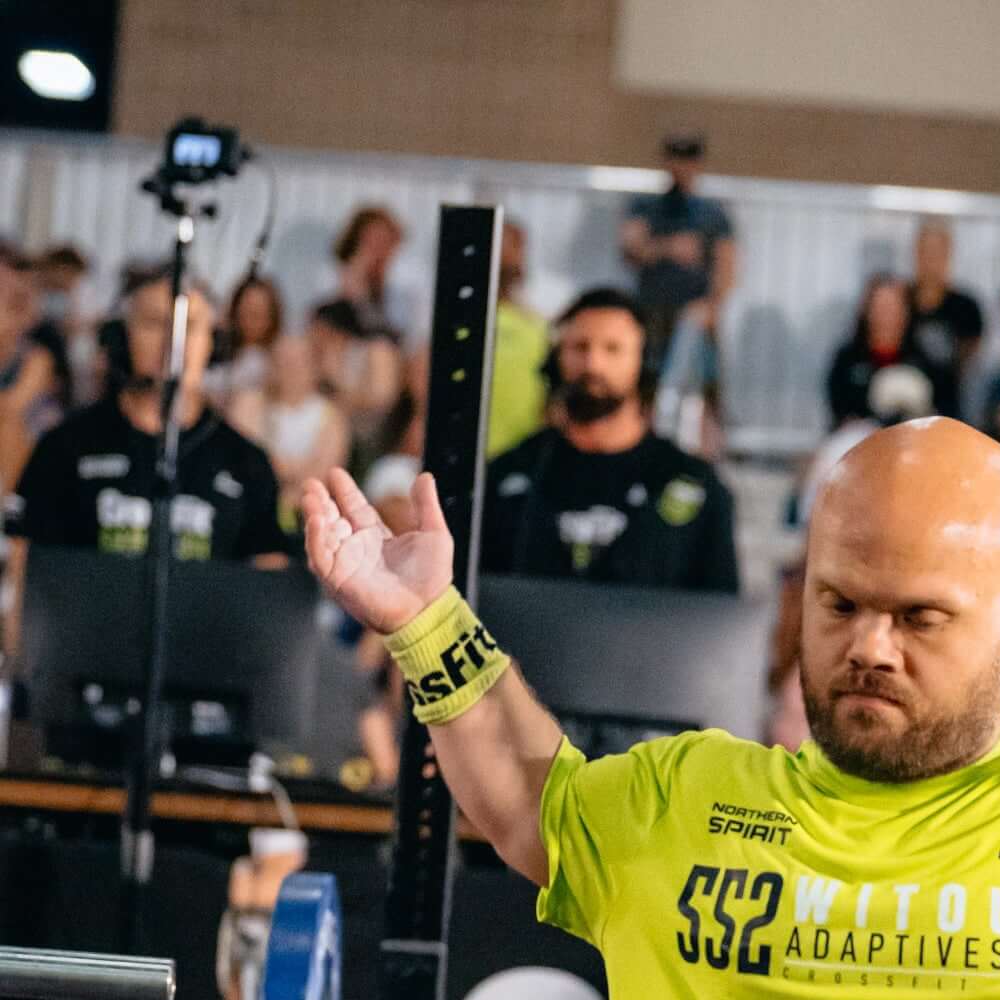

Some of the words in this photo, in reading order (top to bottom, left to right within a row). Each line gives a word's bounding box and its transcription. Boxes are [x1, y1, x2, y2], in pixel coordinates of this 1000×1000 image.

[712, 802, 797, 825] NORTHERN
[708, 816, 792, 846] SPIRIT
[676, 864, 784, 975] 552
